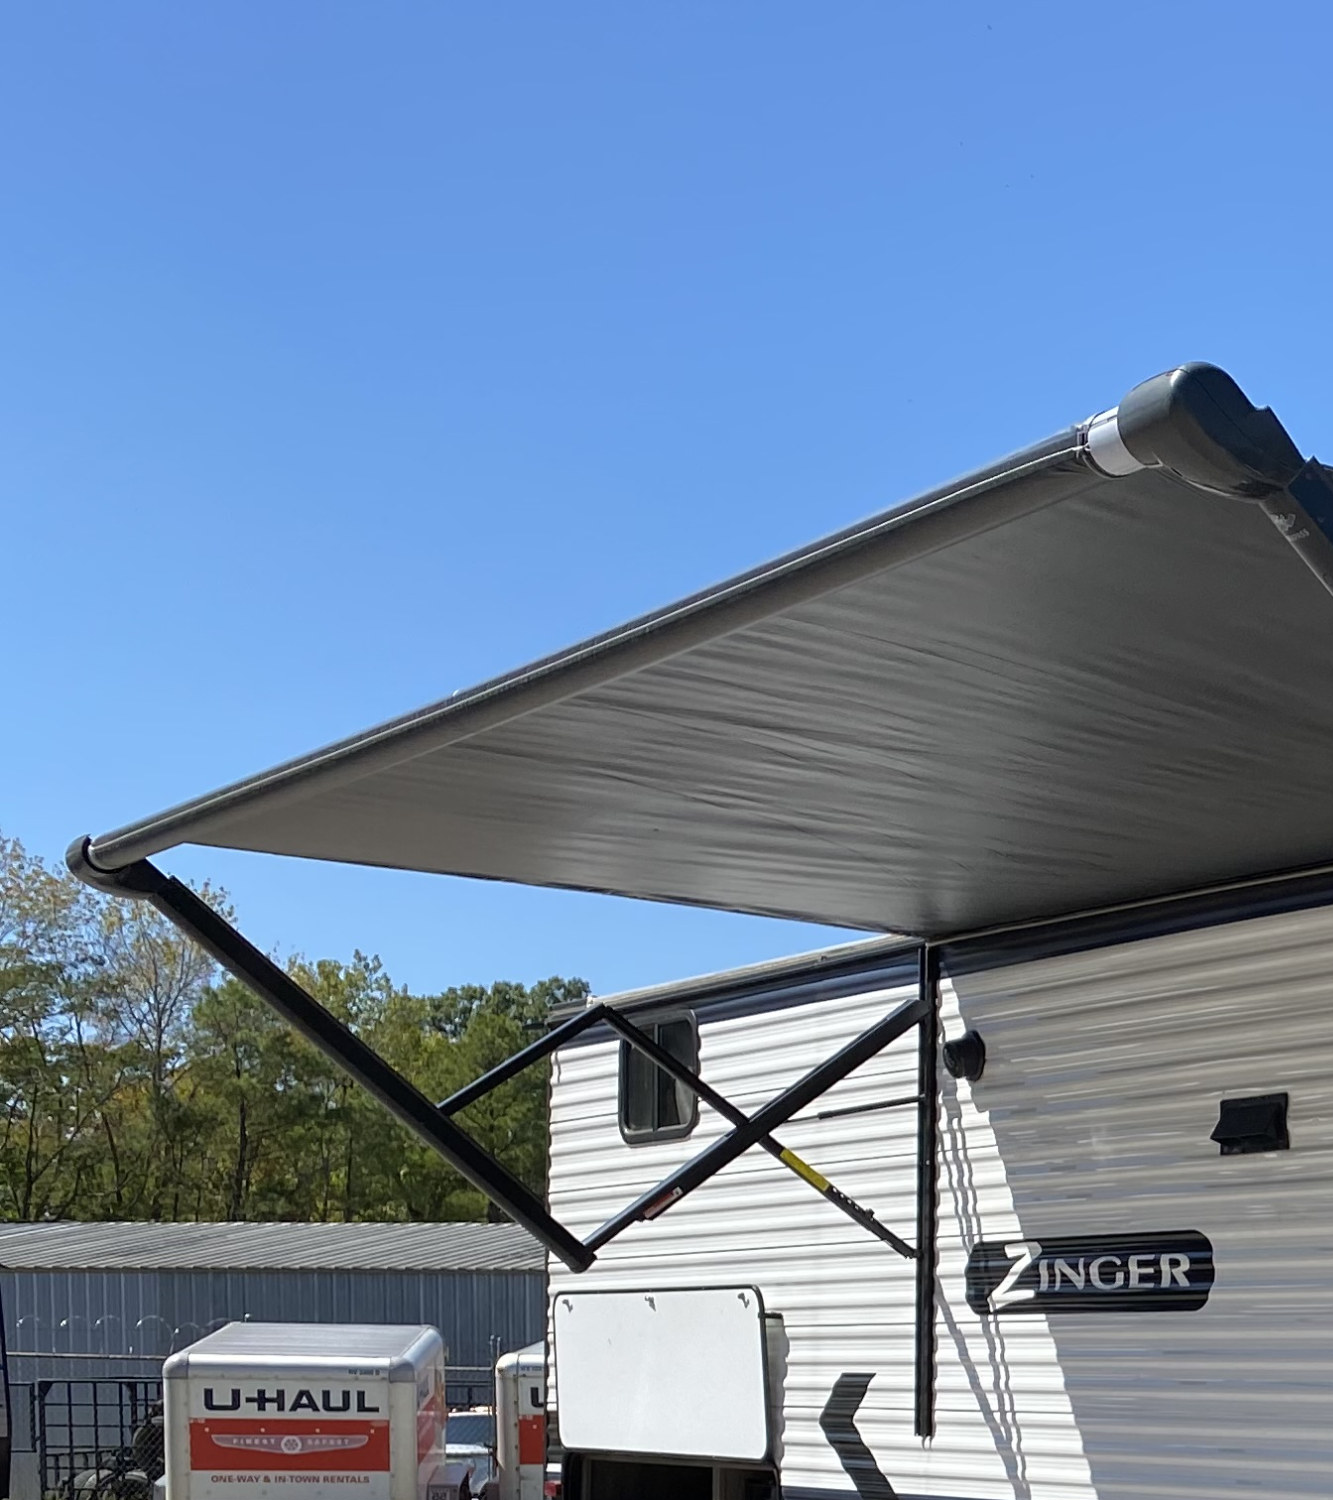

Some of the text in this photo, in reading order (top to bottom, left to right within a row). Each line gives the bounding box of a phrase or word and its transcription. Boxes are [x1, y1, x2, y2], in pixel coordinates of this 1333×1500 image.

[987, 1241, 1191, 1313] ZINGER
[203, 1388, 380, 1412] U-HAUL
[232, 1437, 351, 1446] FINEST SAFEST
[211, 1475, 370, 1484] ONE-WAY & IN-TOWN RENTALS
